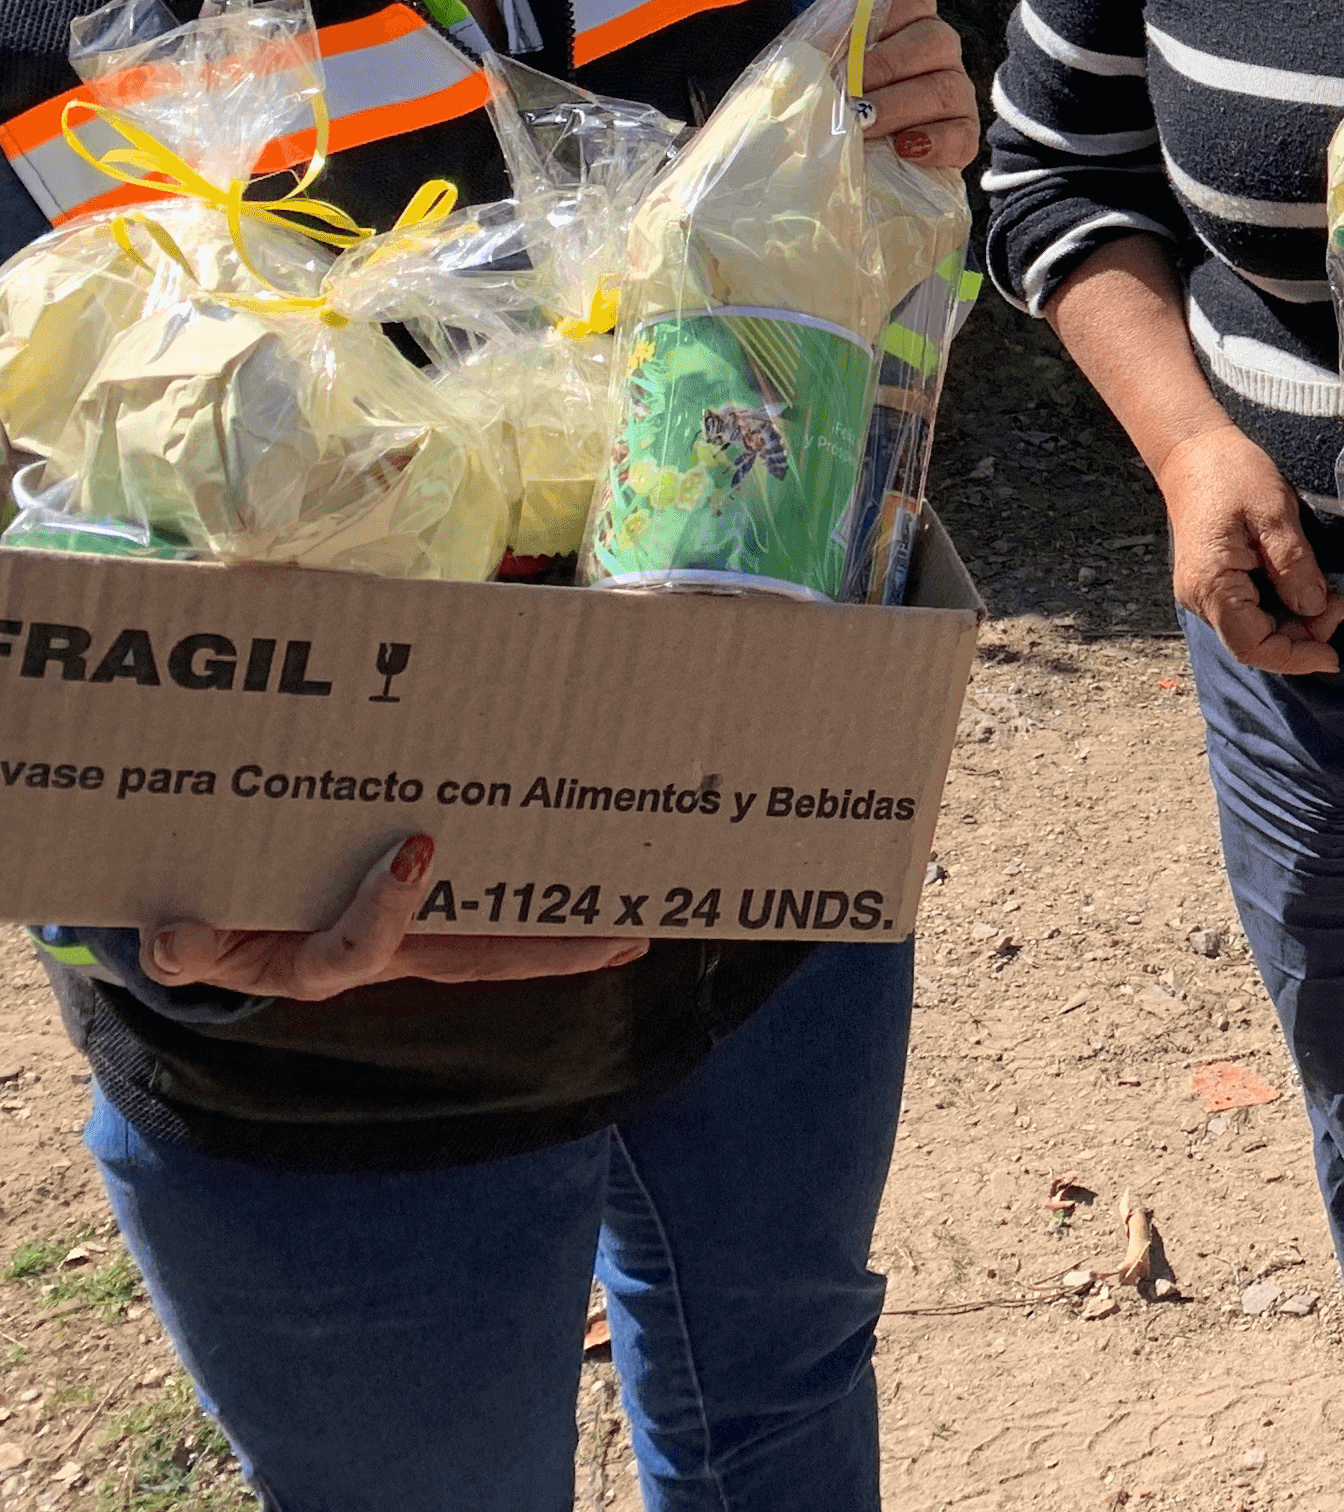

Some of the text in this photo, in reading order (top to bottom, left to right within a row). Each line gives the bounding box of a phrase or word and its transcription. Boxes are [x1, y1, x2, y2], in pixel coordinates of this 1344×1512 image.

[1, 761, 916, 823] vase para Contacto con Alimentos y Bebidas
[411, 879, 894, 930] A-1124 x 24 UNDS.
